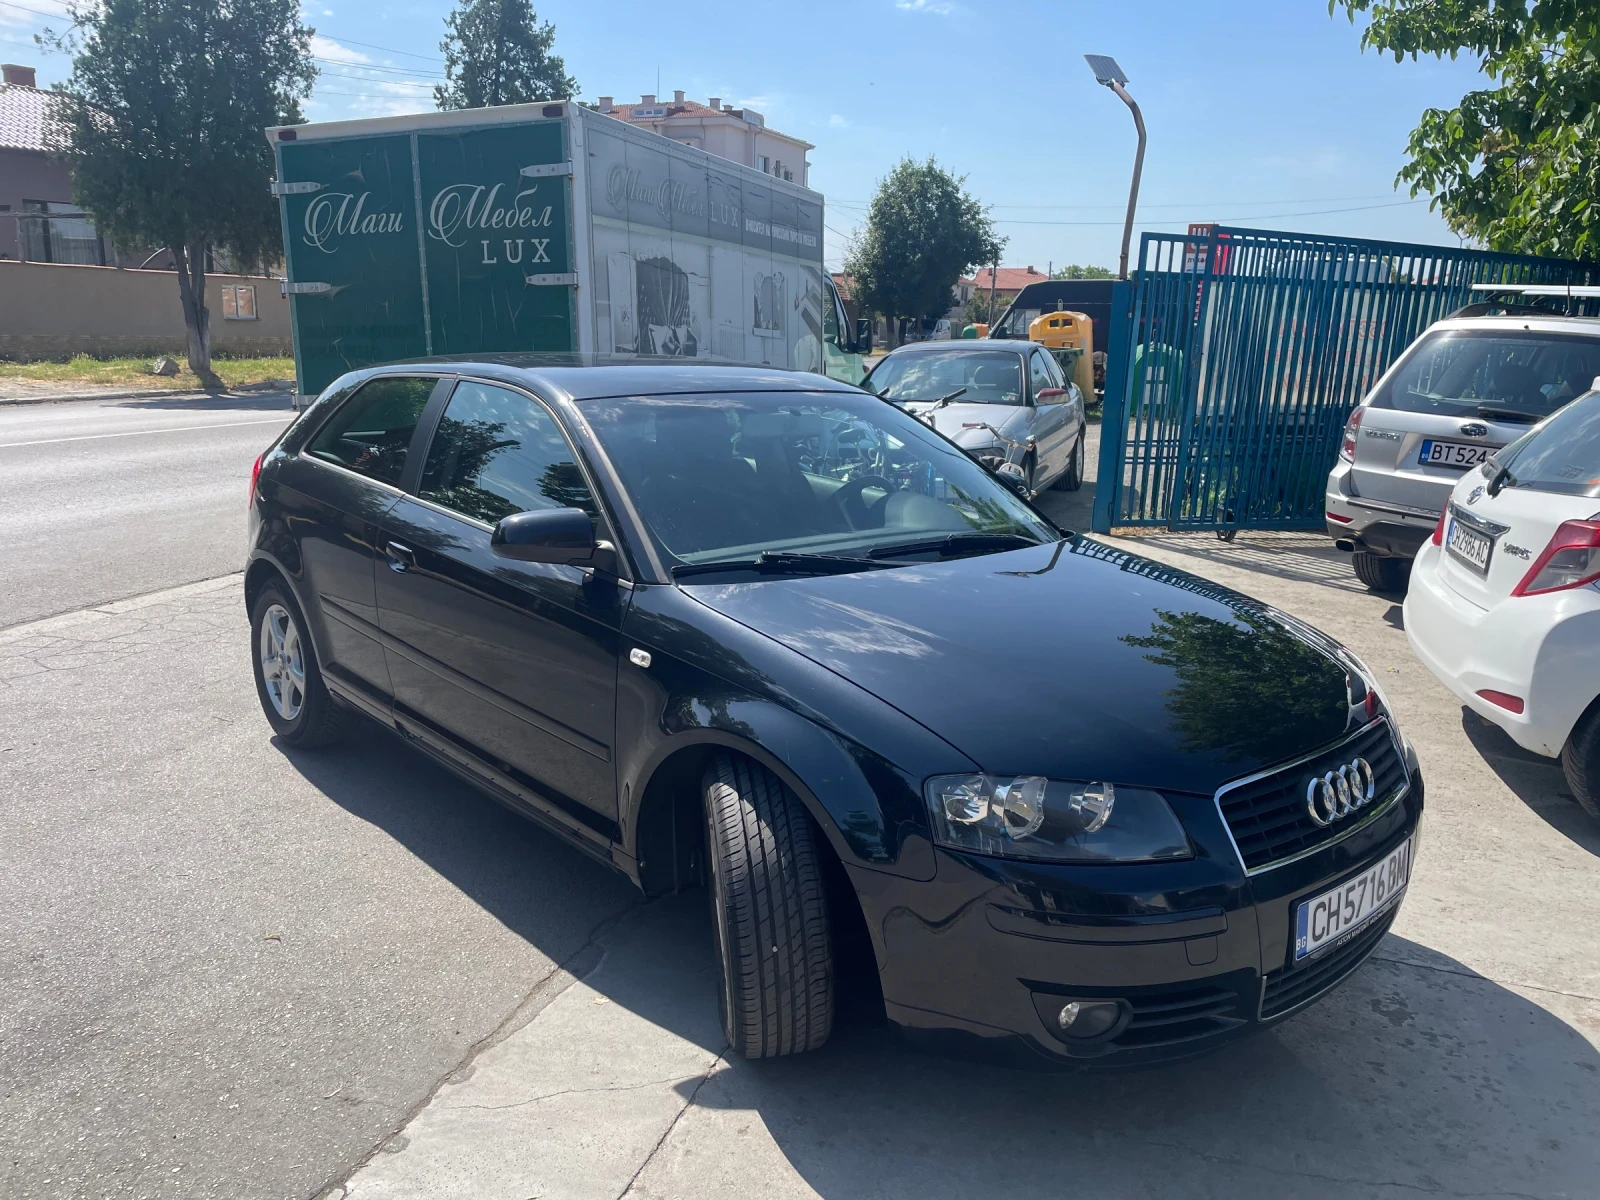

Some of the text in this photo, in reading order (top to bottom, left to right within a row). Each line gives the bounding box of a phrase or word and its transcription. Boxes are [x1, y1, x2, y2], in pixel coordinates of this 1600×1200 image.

[428, 183, 552, 247] Мебел
[710, 201, 739, 228] LUX
[481, 239, 551, 264] LUX
[1296, 935, 1307, 951] BG
